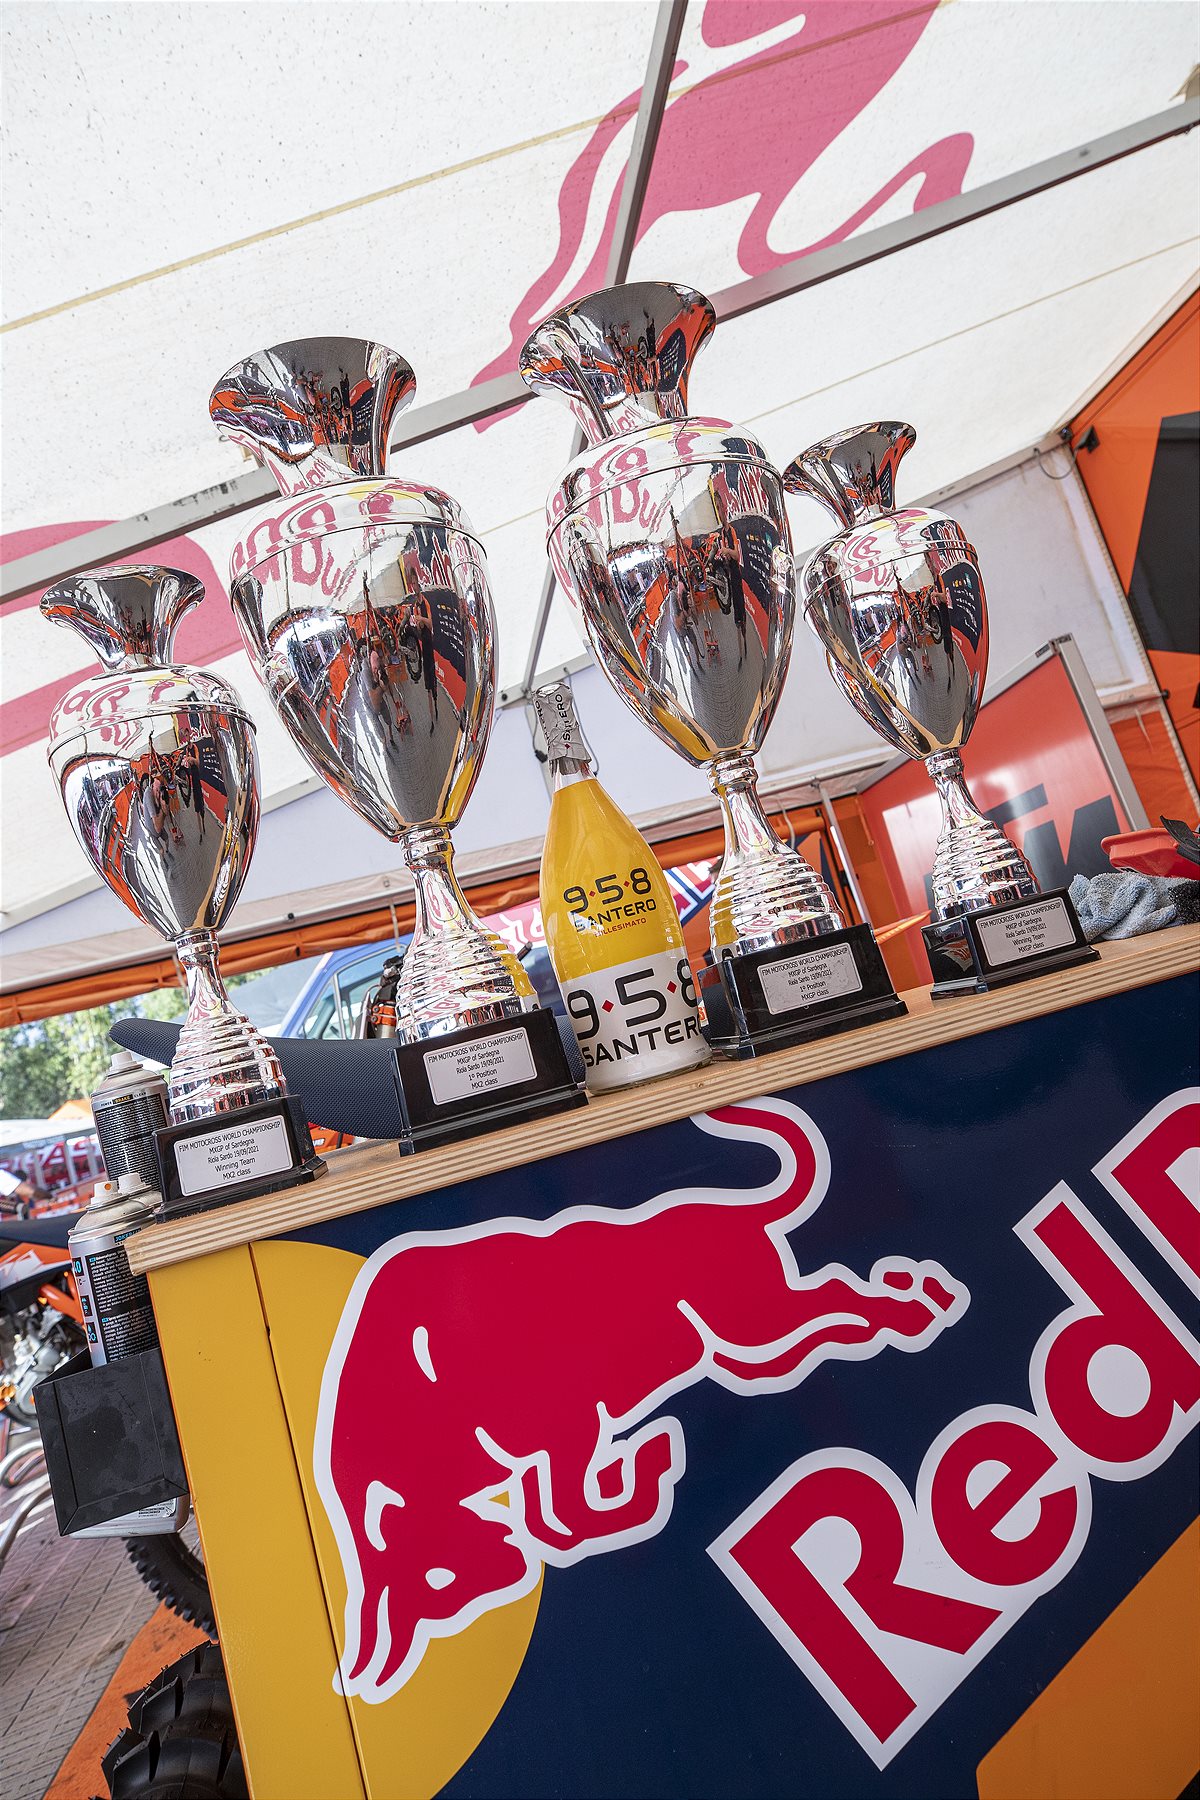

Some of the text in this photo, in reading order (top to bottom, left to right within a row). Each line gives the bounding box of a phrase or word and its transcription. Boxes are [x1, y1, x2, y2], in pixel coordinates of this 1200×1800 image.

[575, 899, 657, 933] SANTERO
[989, 915, 1014, 927] MOTOCROSS
[1015, 909, 1030, 919] WORLD
[1031, 902, 1061, 915] CHAMPIONSHIP
[1023, 917, 1042, 926] Sardegna
[1013, 936, 1031, 945] Winning
[1018, 942, 1044, 953] MXGP class
[771, 961, 798, 974] MOTOCROSS
[800, 957, 815, 966] WORLD
[815, 947, 847, 961] CHAMPIONSHIP
[807, 963, 827, 973] Sardegna
[799, 975, 810, 983] Sardo
[807, 981, 826, 990] Position
[801, 992, 815, 1000] MXGP
[439, 1048, 468, 1060] MOTOCROSS
[470, 1043, 486, 1052] WORLD
[487, 1033, 523, 1047] CHAMPIONSHIP
[582, 1014, 701, 1068] SANTER
[457, 1056, 471, 1064] MXGP
[478, 1049, 499, 1059] Sardegna
[468, 1063, 480, 1071] Sardo
[476, 1069, 497, 1078] Position
[190, 1136, 221, 1149] MOTOCROSS
[222, 1131, 241, 1141] WORLD
[242, 1121, 280, 1136] CHAMPIONSHIP
[209, 1145, 223, 1154] MXGP
[232, 1138, 254, 1148] Sardegna
[215, 1157, 255, 1172] Winning Team
[223, 1168, 251, 1180] MX2 class
